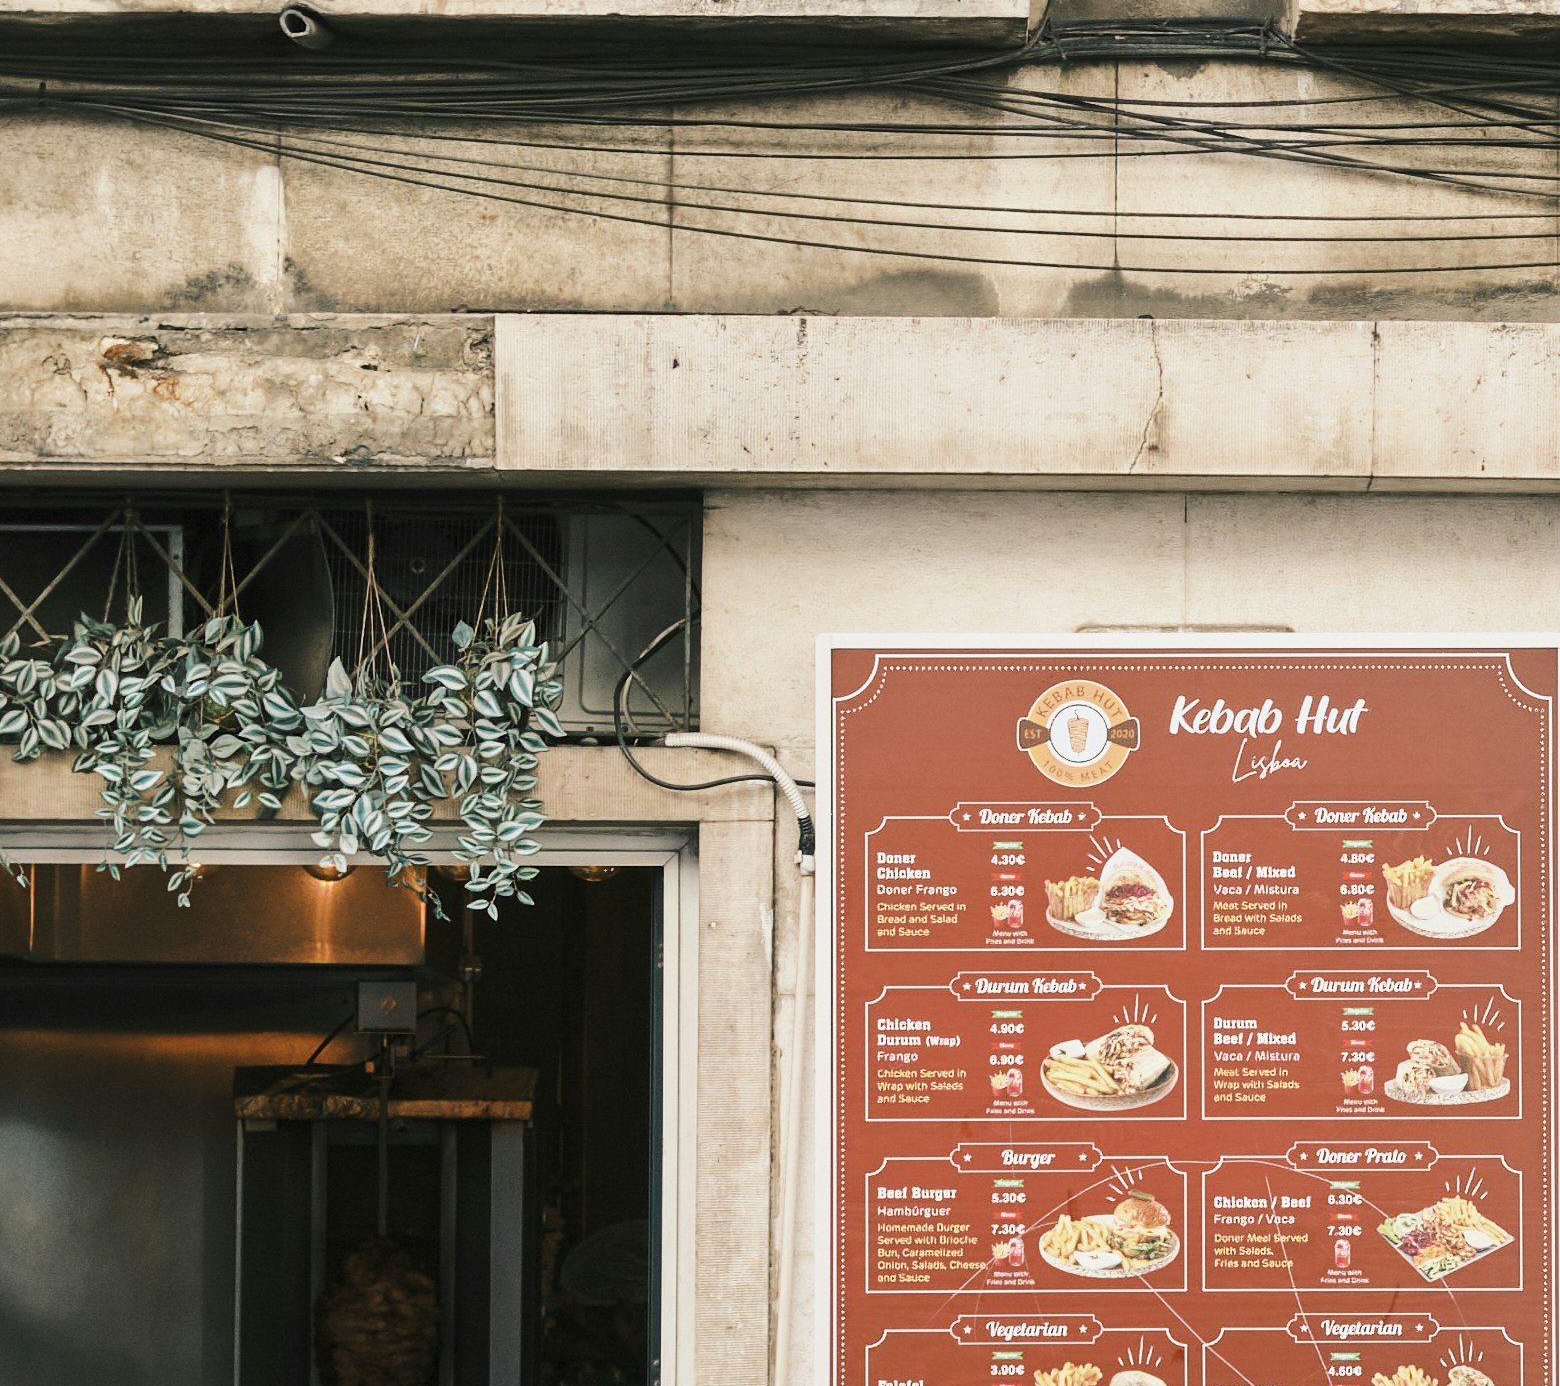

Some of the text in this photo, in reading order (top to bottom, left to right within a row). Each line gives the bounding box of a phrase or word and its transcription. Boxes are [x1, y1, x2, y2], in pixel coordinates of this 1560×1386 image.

[1036, 686, 1122, 717] KEBAB HUT
[1168, 694, 1369, 738] Kebab Hut
[1024, 728, 1042, 739] EST
[1110, 729, 1135, 739] 2020
[1231, 738, 1308, 783] Lisboa
[1080, 760, 1113, 781] MEAT
[979, 809, 1072, 824] Doner Kebab
[1315, 806, 1407, 823] Doner Kebab
[877, 852, 915, 864] Doner
[991, 855, 1025, 865] 4.30€
[1213, 851, 1251, 863] Doner
[1340, 854, 1374, 863] 4.80€
[877, 867, 930, 880] Chicken
[1213, 866, 1295, 878] Beef Mixed
[877, 885, 957, 896] Doner Frango
[991, 886, 1024, 896] 6.30€
[1214, 884, 1299, 895] Vaca Mistura
[1340, 884, 1374, 895] 6.80€
[975, 978, 1077, 993] Durum Kebab
[1311, 977, 1413, 992] Durum Kebab
[878, 1018, 931, 1031] Chicken
[990, 1023, 1024, 1033] 4.90€
[1214, 1017, 1257, 1029] Durum
[1342, 1020, 1375, 1031] 5.30€
[877, 1034, 960, 1047] Durum (Wrap)
[1214, 1032, 1296, 1045] Beef Mixed
[877, 1051, 918, 1063] Frango
[1214, 1051, 1300, 1061] Vaca Mistura
[1341, 1052, 1375, 1062] 7.30€
[1002, 1149, 1055, 1169] Burger
[1316, 1148, 1407, 1163] Doner Prato
[878, 1187, 957, 1201] Beef Burger
[992, 1193, 1026, 1203] 5.30€
[1328, 1194, 1363, 1205] 6.30€
[1214, 1196, 1311, 1208] Chicken Beef
[1214, 1213, 1294, 1226] Frango Vaca
[991, 1224, 1026, 1235] 7.30€
[1327, 1226, 1362, 1236] 7.30€
[986, 1321, 1067, 1341] Vegetarian
[1321, 1320, 1402, 1339] Vegetarian
